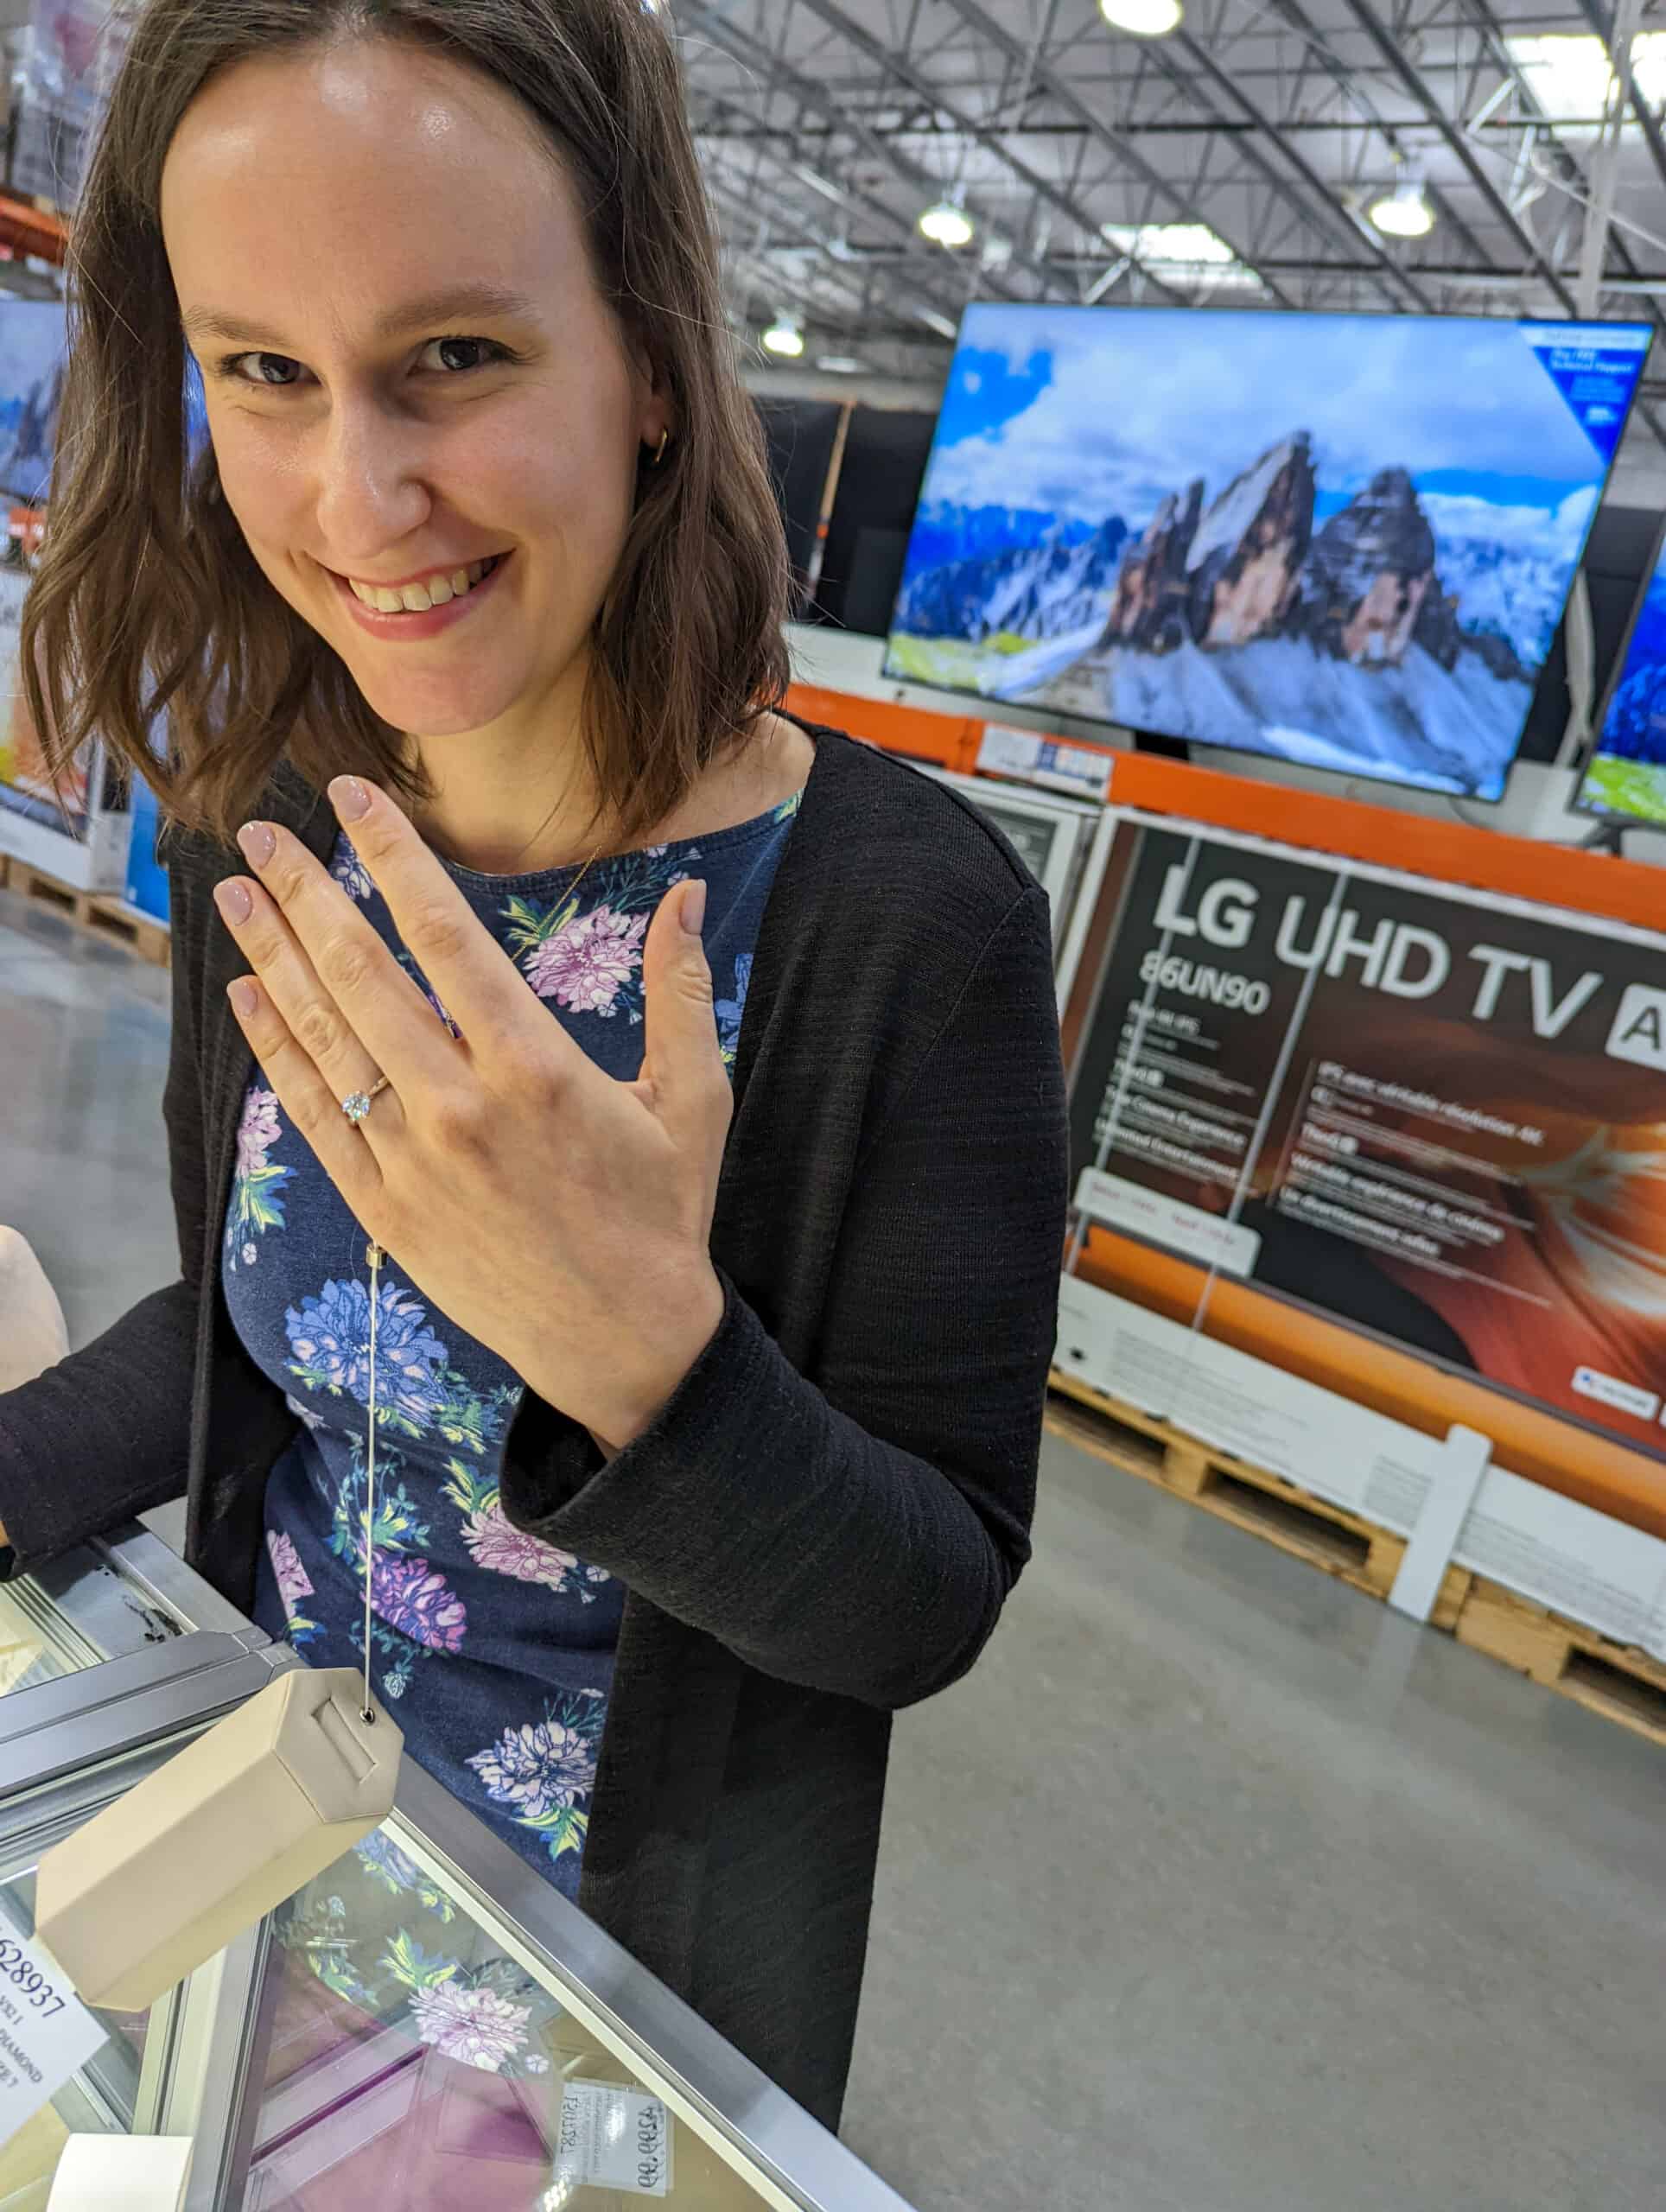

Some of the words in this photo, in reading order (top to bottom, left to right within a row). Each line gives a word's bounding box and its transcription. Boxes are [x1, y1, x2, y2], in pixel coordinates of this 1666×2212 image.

[1140, 950, 1271, 1015] 86UN90
[1154, 864, 1260, 948] LG
[1275, 895, 1451, 1000] UHD
[1469, 944, 1604, 1039] TV
